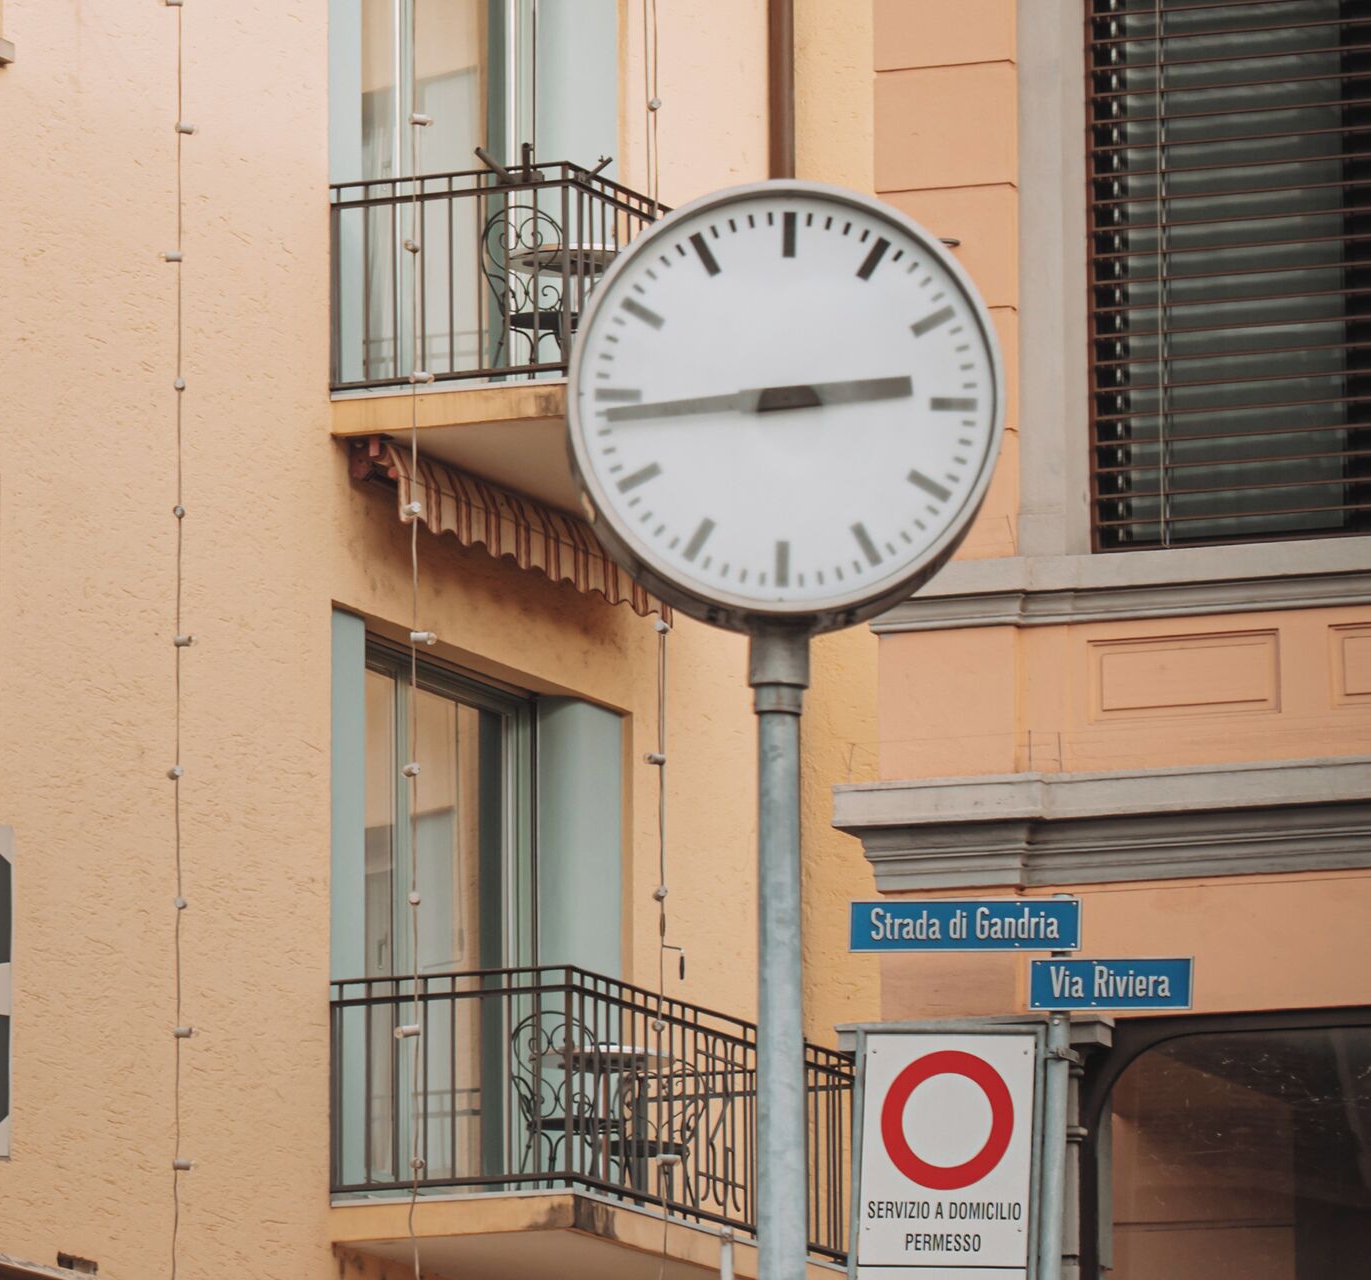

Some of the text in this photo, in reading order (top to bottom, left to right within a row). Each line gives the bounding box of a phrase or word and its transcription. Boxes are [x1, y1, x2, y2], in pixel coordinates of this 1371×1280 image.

[870, 907, 1059, 940] Strada di Gandria
[1050, 965, 1170, 999] Via Riviera
[867, 1200, 1022, 1220] SERVIZIO A DOMICILIO
[905, 1233, 981, 1252] PERMESSO
